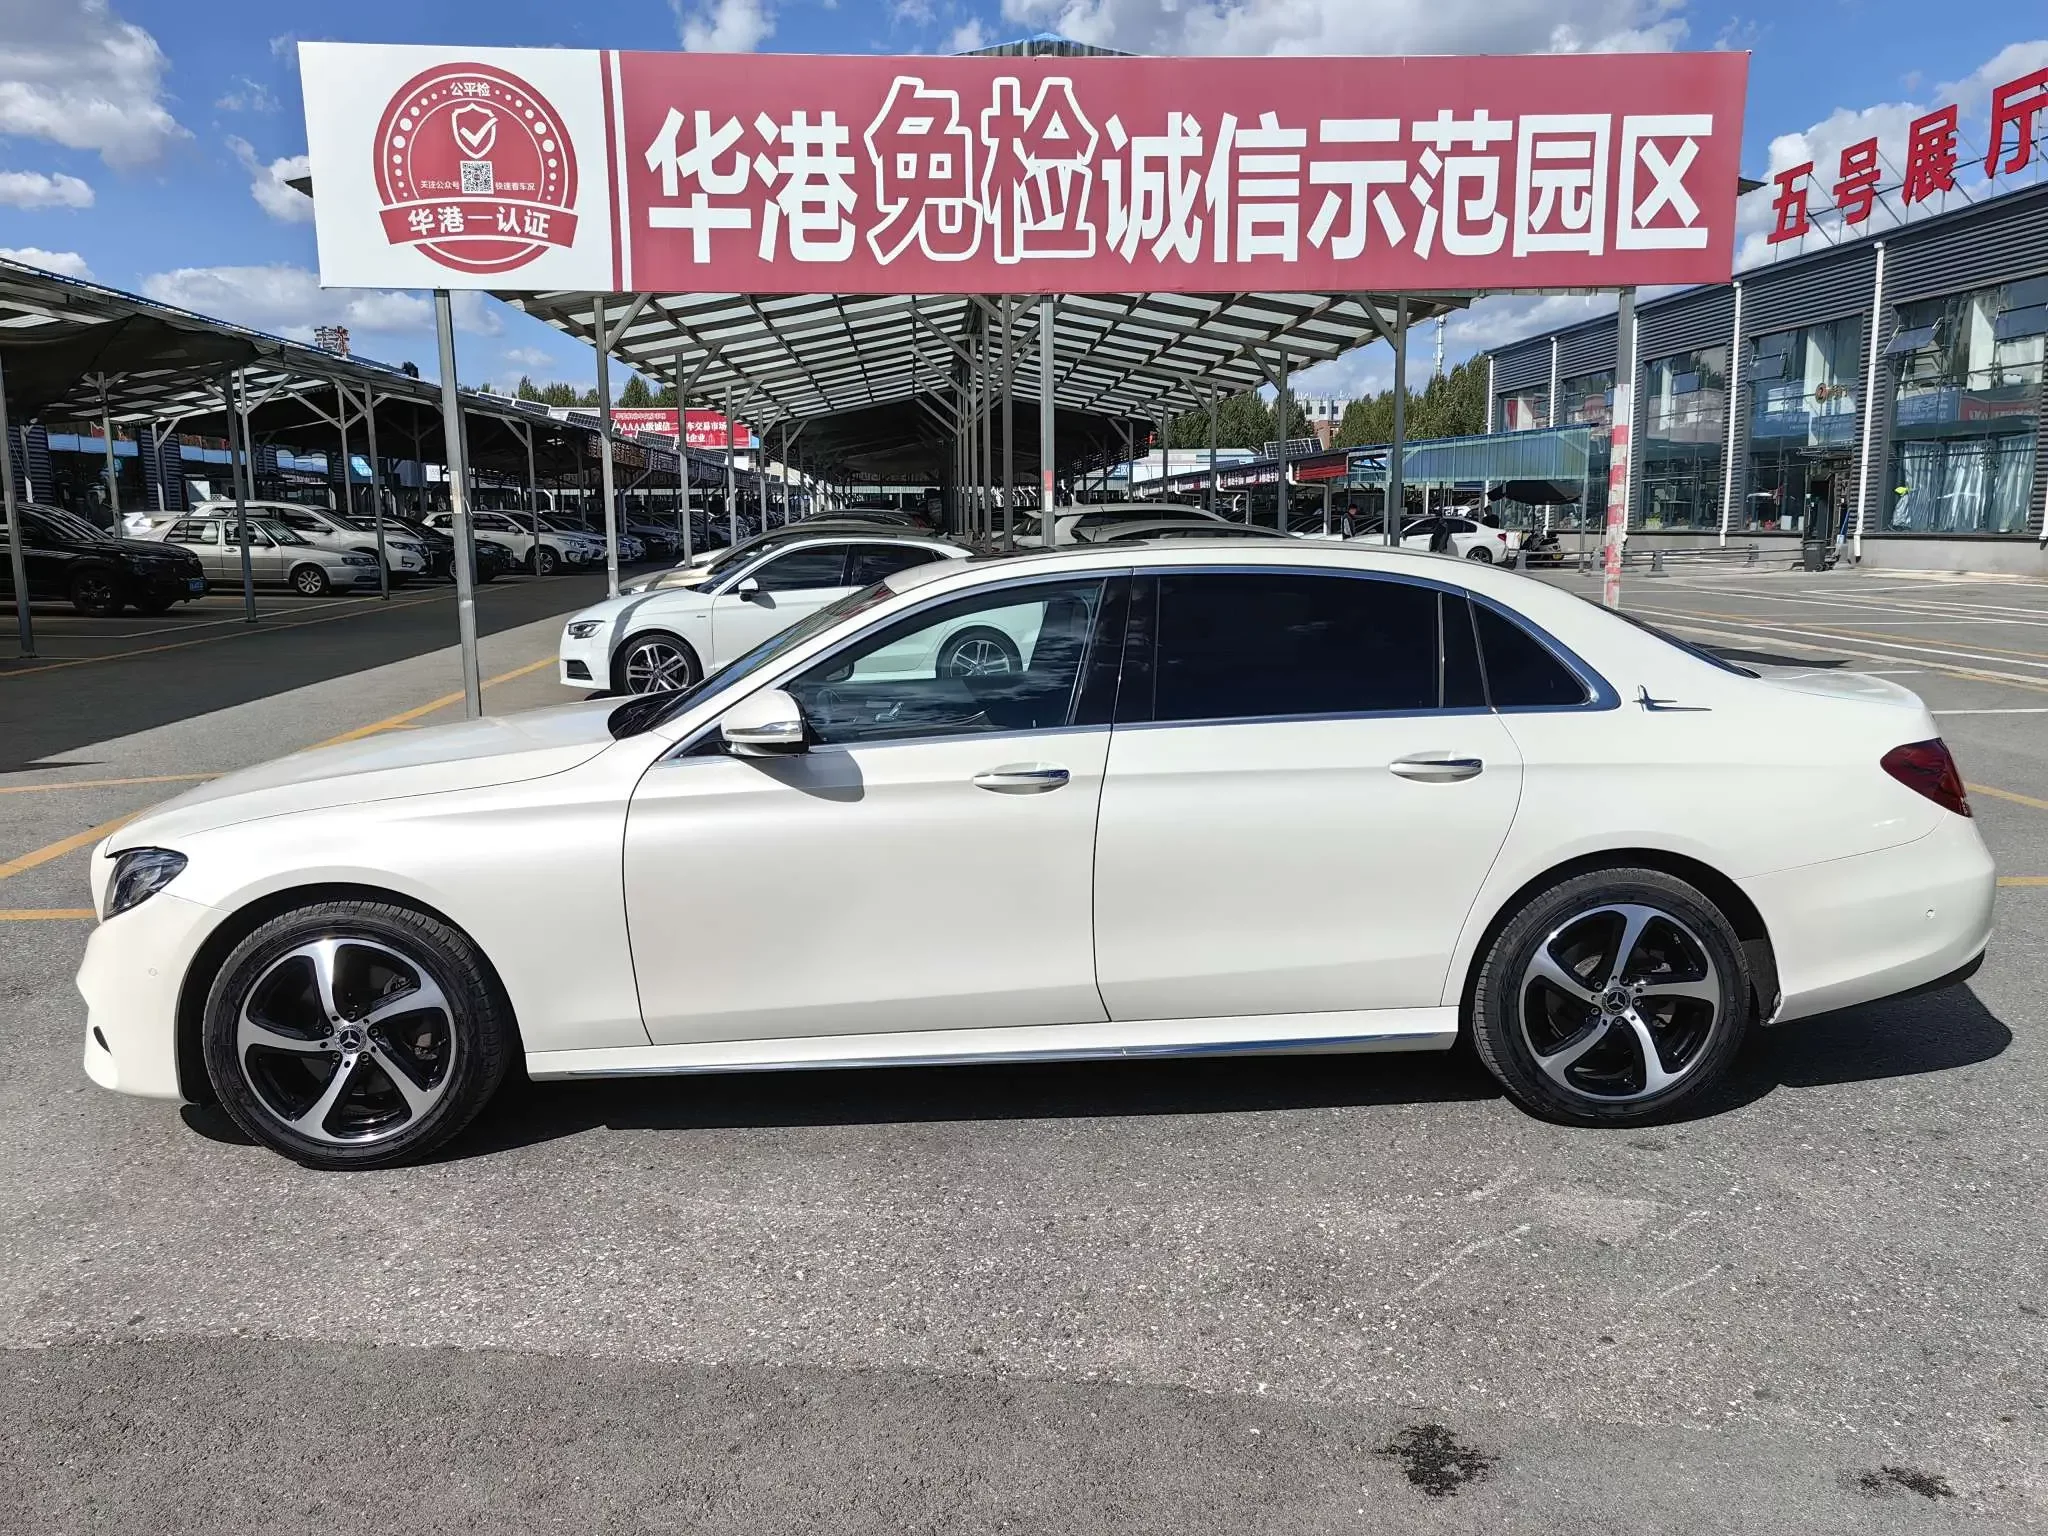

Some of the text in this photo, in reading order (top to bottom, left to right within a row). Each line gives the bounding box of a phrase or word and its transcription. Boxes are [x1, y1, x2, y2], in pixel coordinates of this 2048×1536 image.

[450, 81, 491, 98] 公平检
[1767, 67, 2048, 245] 五号展厅
[645, 75, 1714, 266] 华港免检诚信示范园区
[496, 182, 536, 192] 快速看车况
[408, 206, 551, 239] 华港一认证
[616, 421, 728, 432] AAAAA级诚信二车交易市场
